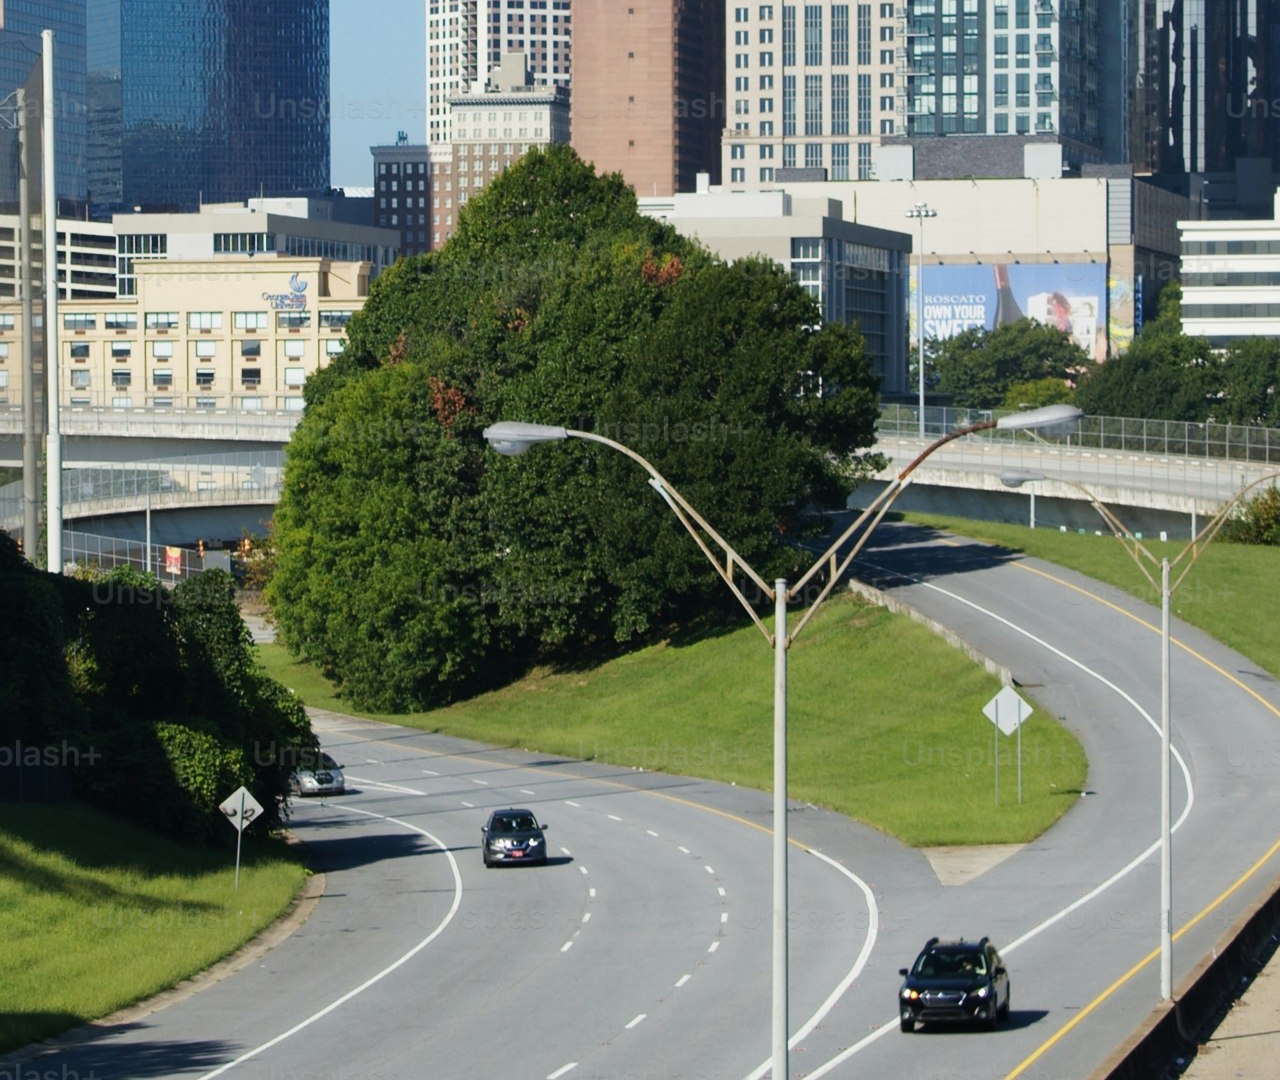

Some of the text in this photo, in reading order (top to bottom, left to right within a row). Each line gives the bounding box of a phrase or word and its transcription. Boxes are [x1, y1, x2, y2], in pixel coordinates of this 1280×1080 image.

[924, 295, 986, 304] ROSCATO
[923, 305, 985, 320] OWN YOUR
